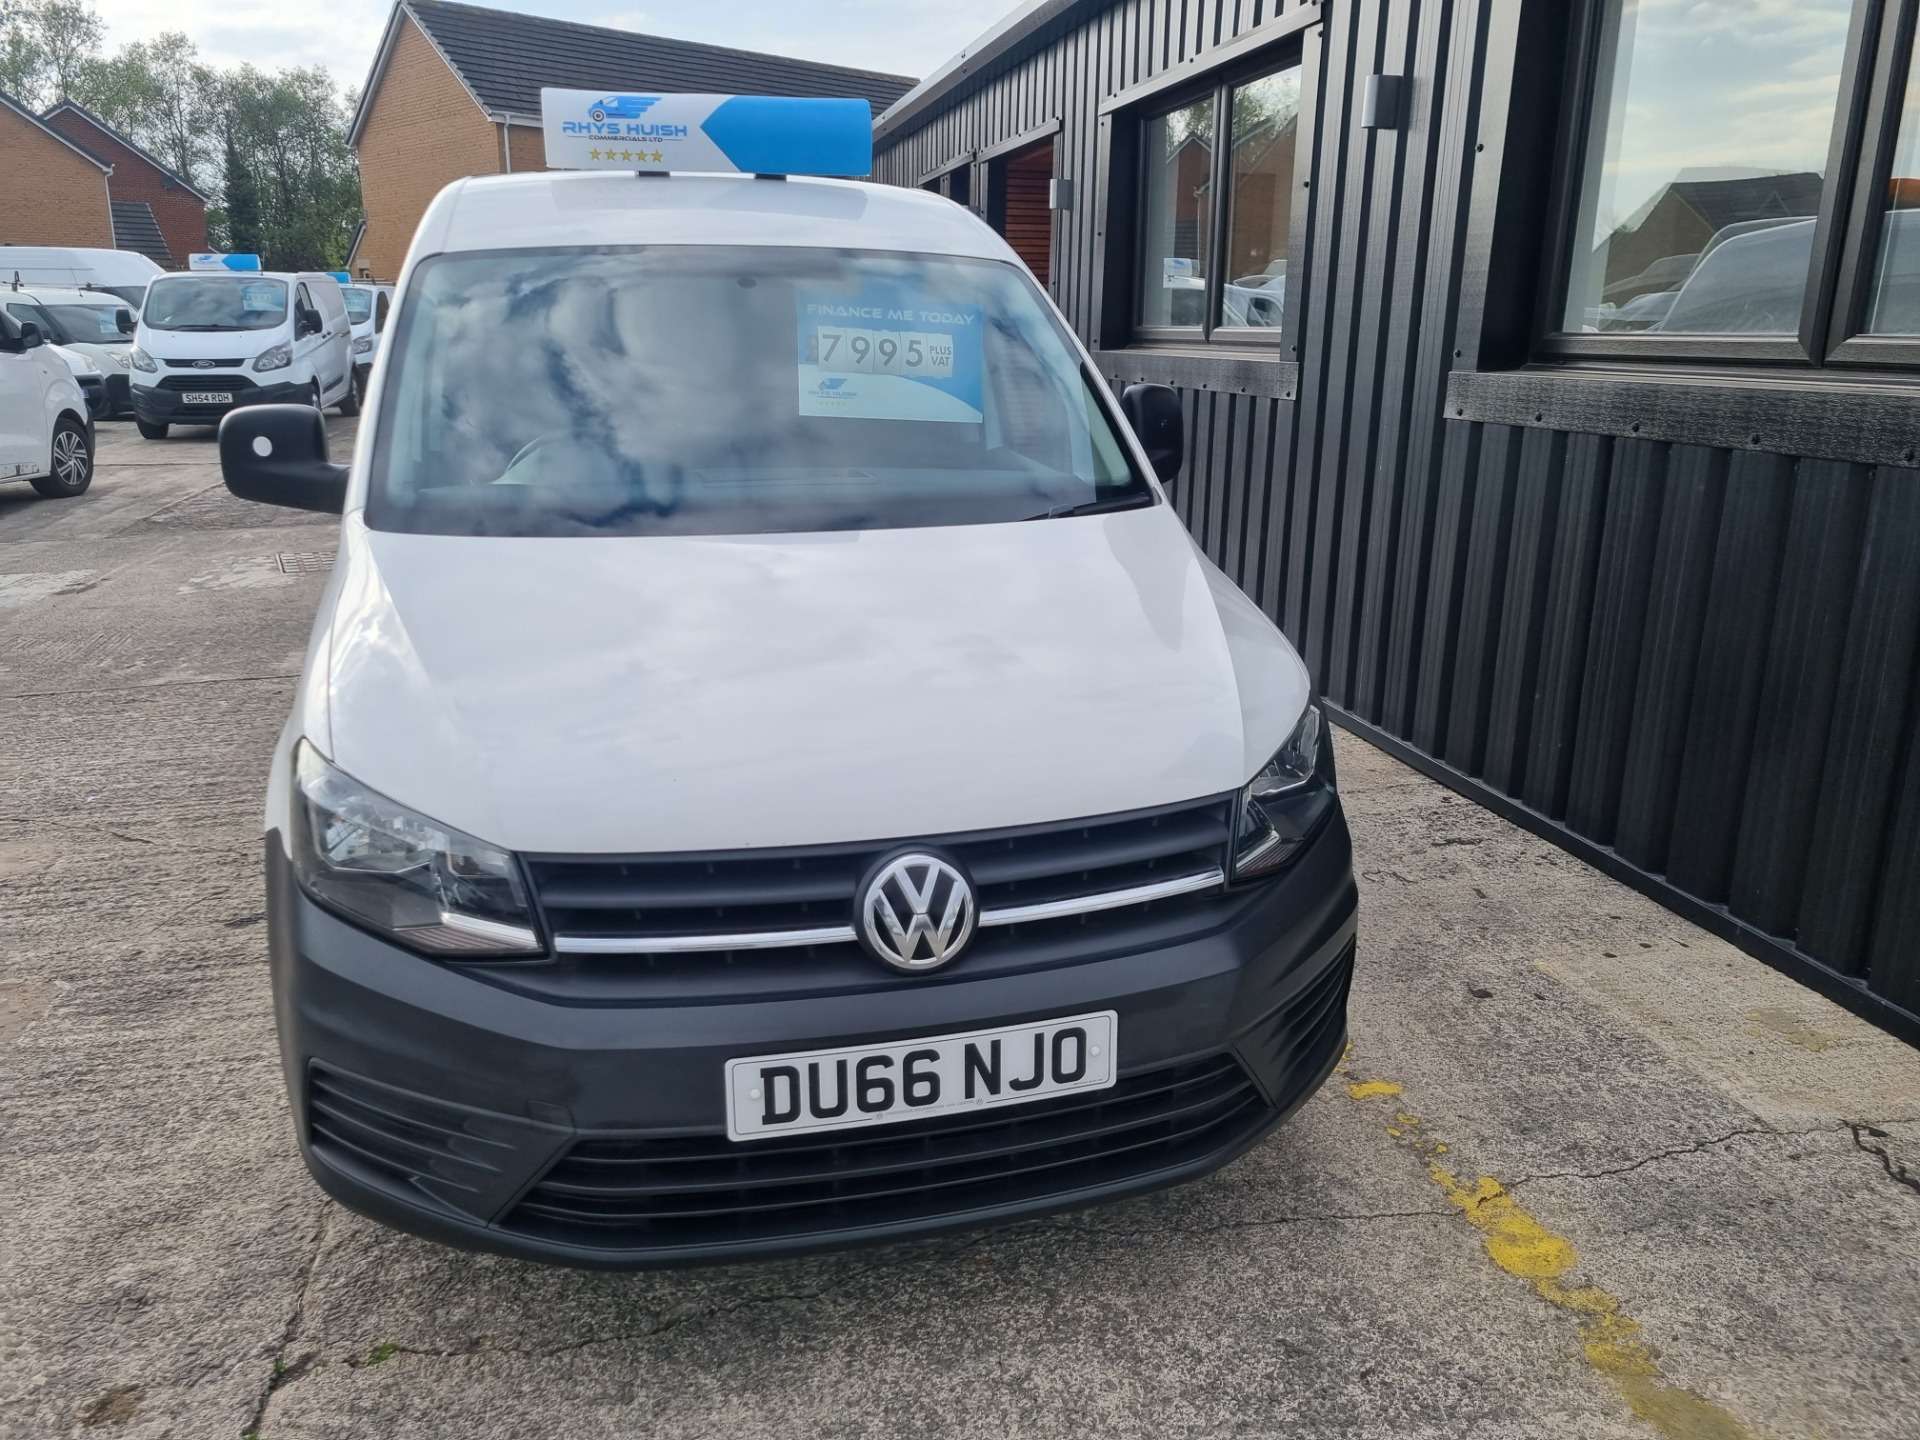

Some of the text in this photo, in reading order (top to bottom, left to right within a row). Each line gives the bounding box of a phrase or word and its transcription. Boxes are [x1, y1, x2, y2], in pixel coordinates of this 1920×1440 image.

[562, 121, 688, 137] RHYS HUISH
[588, 134, 647, 142] COMMERCIALS
[807, 304, 975, 325] FINANCE ME TODAY
[821, 333, 924, 368] 7995
[929, 345, 952, 356] PLUS
[930, 356, 951, 368] VAT
[759, 1027, 1088, 1125] DU66 NJO
